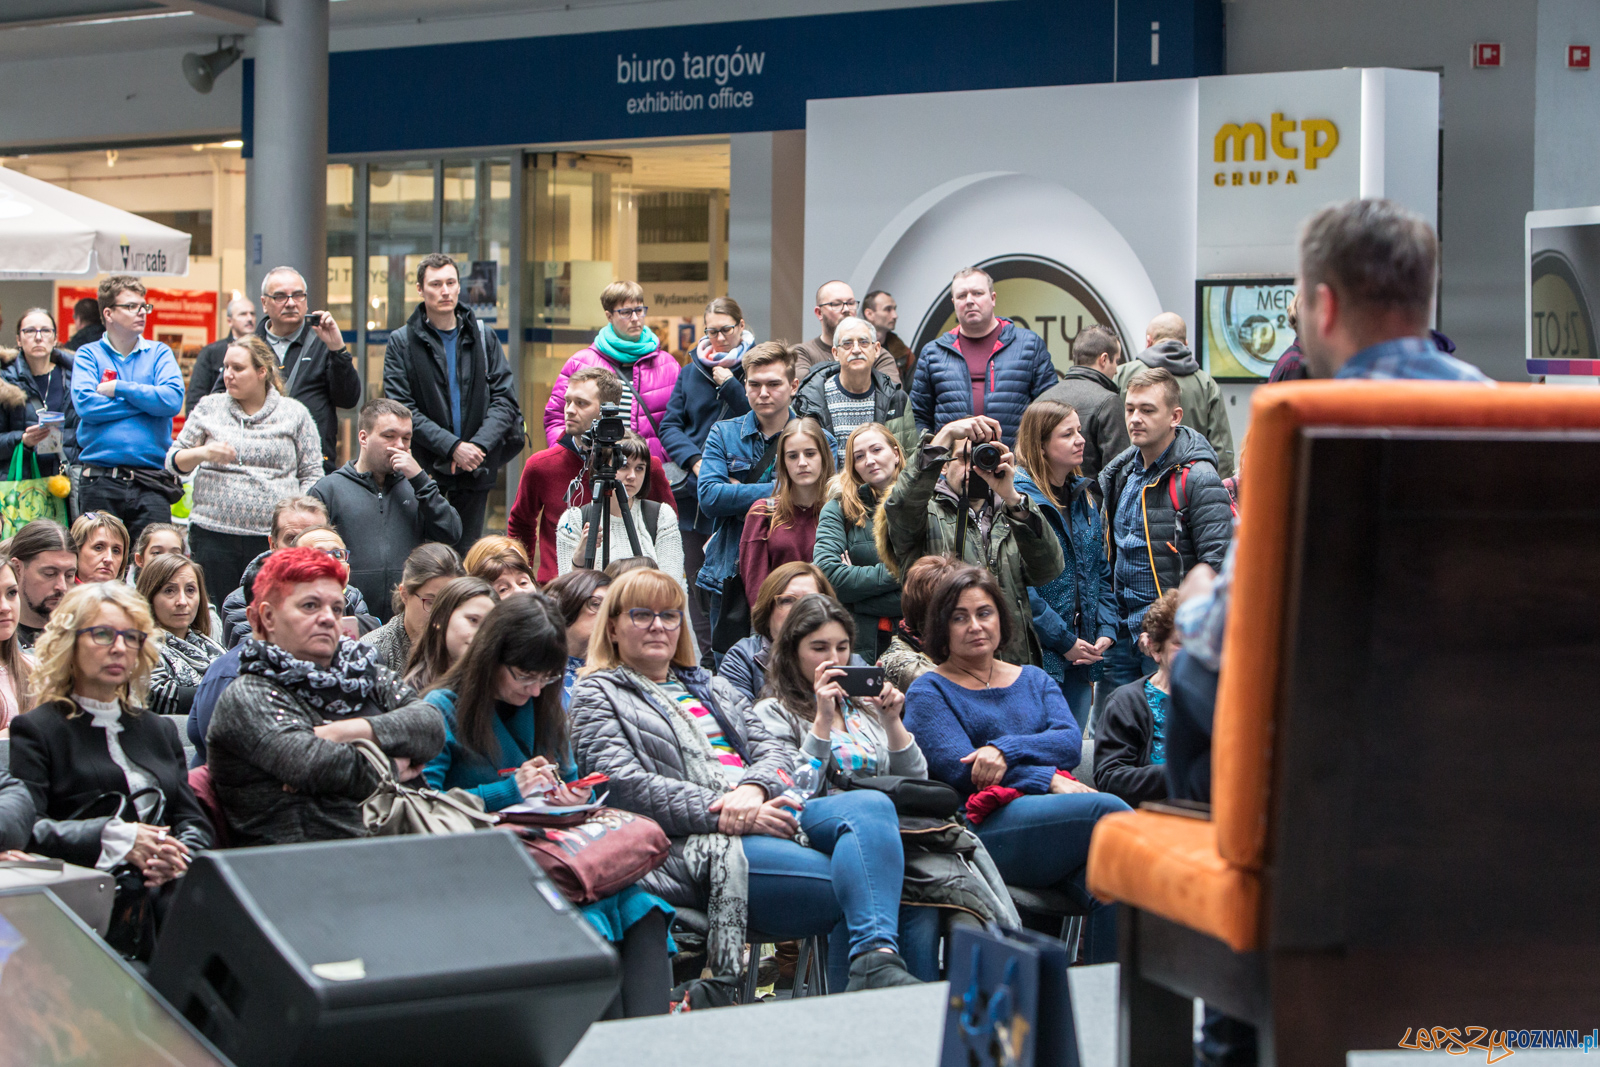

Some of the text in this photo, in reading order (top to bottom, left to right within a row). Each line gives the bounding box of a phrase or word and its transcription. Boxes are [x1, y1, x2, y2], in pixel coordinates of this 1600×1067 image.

[616, 44, 765, 86] biuro targów
[626, 86, 754, 114] exhibition office
[1213, 111, 1340, 170] mtp
[1213, 169, 1297, 187] GRUPA
